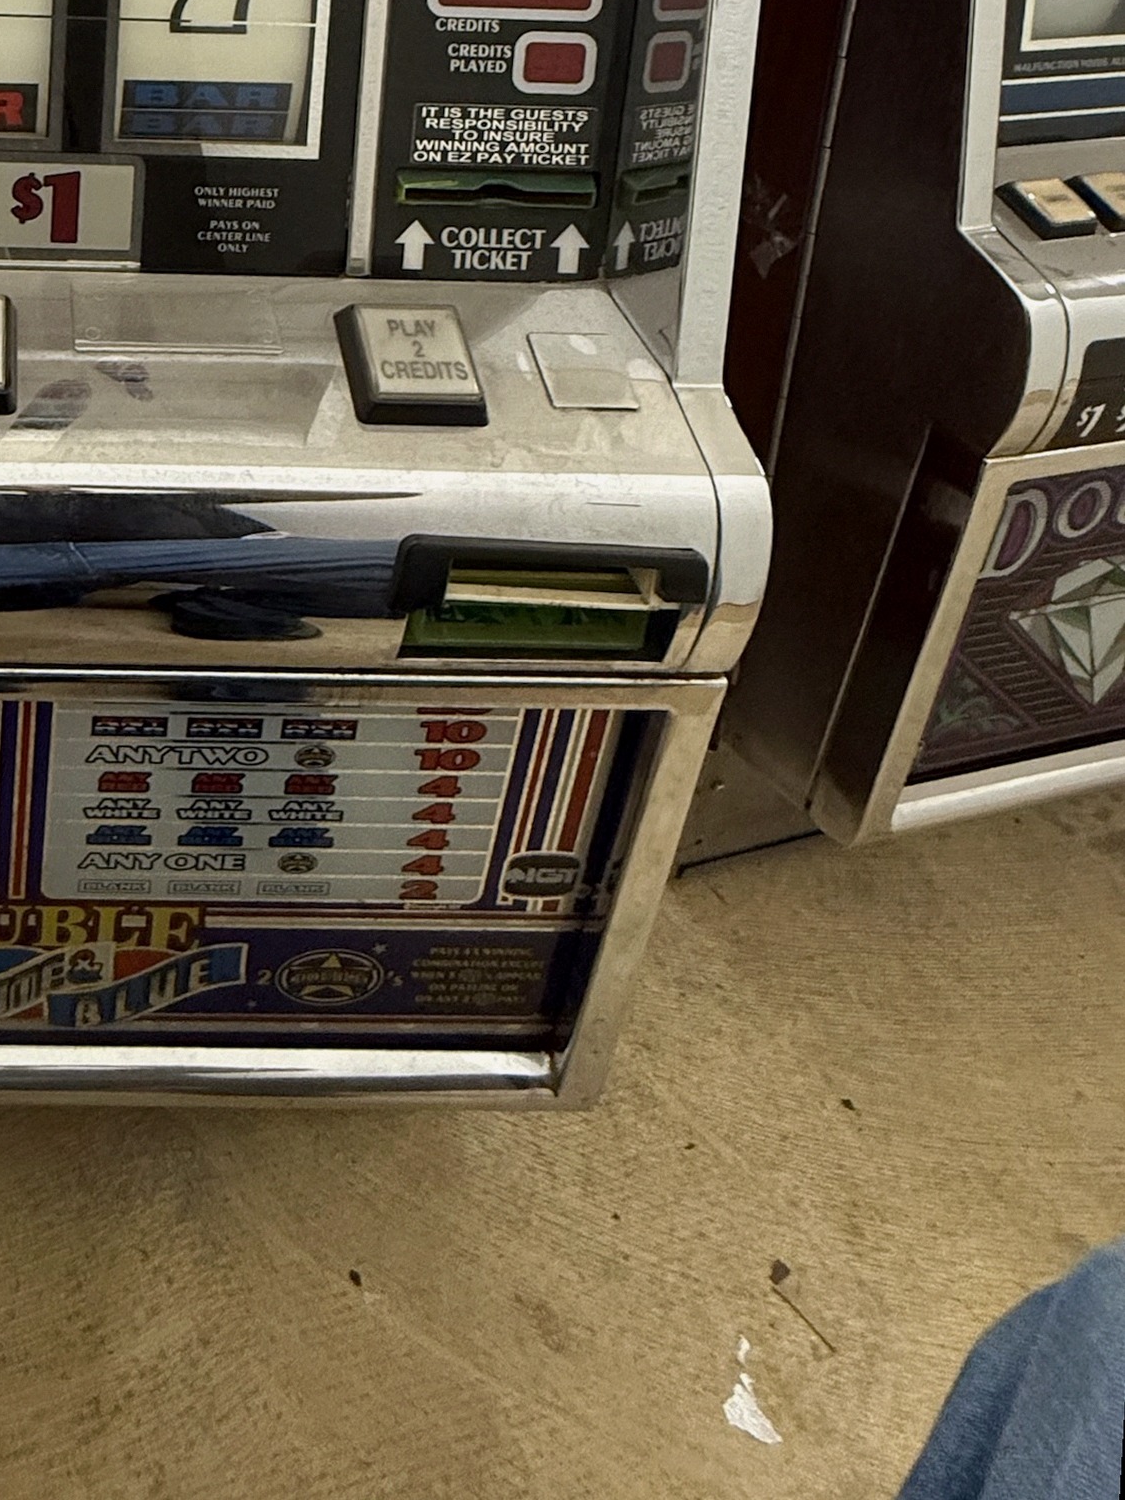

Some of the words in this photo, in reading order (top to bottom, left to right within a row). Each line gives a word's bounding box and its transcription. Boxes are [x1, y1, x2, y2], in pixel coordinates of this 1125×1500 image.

[435, 18, 500, 33] CREDITS
[447, 44, 513, 58] CREDITS
[449, 59, 507, 74] PLAYED
[421, 106, 439, 118] IT
[443, 107, 461, 118] IS
[474, 108, 505, 120] THE
[510, 109, 589, 122] GUESTS
[425, 118, 585, 132] RESPONSIBILITY
[451, 130, 479, 140] TO
[483, 131, 555, 142] INSURE
[415, 140, 501, 152] WINNING
[505, 142, 589, 154] AMOUNT
[413, 152, 443, 163] ON
[447, 152, 472, 163] EZ
[477, 152, 516, 164] PAY
[521, 153, 590, 166] TICKET
[194, 186, 225, 197] ONLY
[229, 187, 279, 198] HIGHEST
[11, 170, 81, 244] $1
[197, 198, 244, 208] WINNER
[246, 200, 275, 210] PAID
[209, 220, 239, 230] PAYS
[242, 221, 260, 230] ON
[197, 231, 243, 242] CENTER
[245, 232, 271, 242] LINE
[441, 226, 547, 250] COLLECT
[217, 242, 249, 252] ONLY
[451, 250, 532, 270] TICKET
[387, 319, 436, 337] PLAY
[412, 341, 425, 358] 2
[380, 360, 469, 381] CREDITS
[85, 745, 175, 766] ANY
[175, 746, 269, 766] TWO
[414, 748, 481, 771] 10
[78, 852, 162, 871] ANY
[163, 852, 246, 871] ONE
[401, 853, 446, 877] 4
[76, 959, 211, 1027] BLUE
